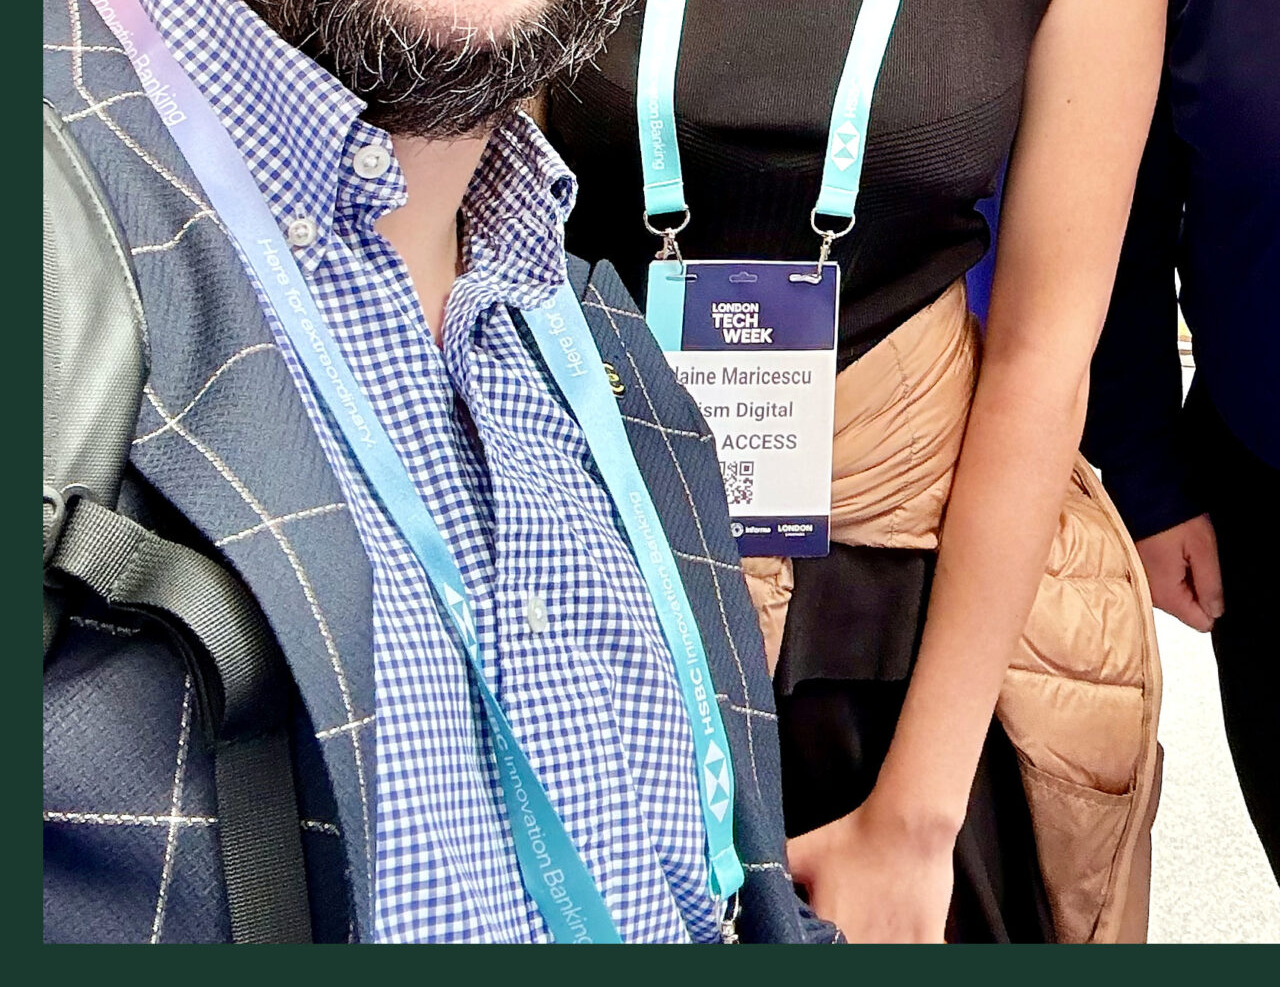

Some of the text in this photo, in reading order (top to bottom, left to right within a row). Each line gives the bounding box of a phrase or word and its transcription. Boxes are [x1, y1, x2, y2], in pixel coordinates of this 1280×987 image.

[134, 54, 188, 127] Banking
[649, 120, 667, 171] Banking
[257, 238, 290, 286] Here
[285, 289, 308, 315] for
[711, 302, 760, 313] LONDON
[546, 313, 567, 335] for
[711, 313, 760, 328] TECH
[723, 328, 773, 344] WEEK
[560, 336, 588, 377] Here
[721, 366, 812, 386] Maricescu
[736, 401, 794, 422] Digital
[721, 434, 798, 450] ACCESS
[777, 524, 814, 533] LONDON
[629, 490, 715, 735] HSBC Innovation Banking
[503, 756, 551, 869] Innovation
